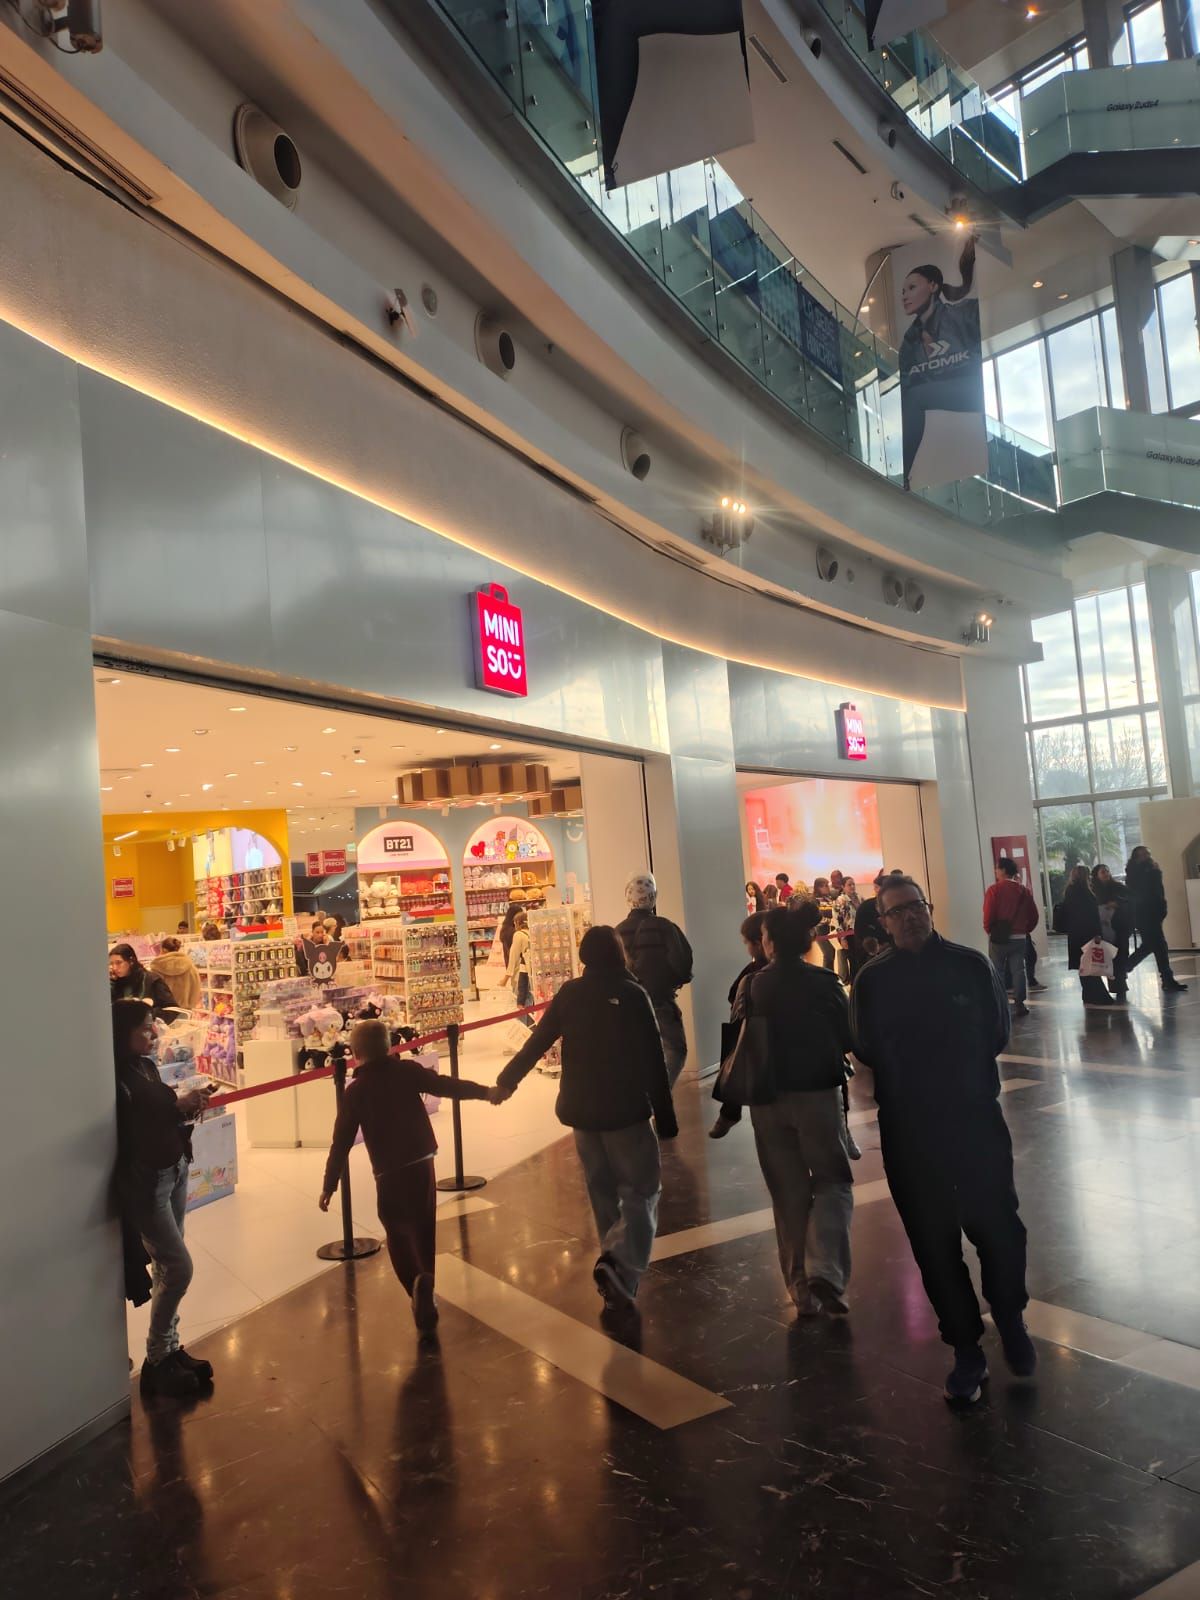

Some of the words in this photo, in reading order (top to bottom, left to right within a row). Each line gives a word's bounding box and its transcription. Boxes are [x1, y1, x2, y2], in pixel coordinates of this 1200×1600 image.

[909, 350, 970, 376] ATOMIK
[1146, 451, 1174, 464] Galaxy
[483, 609, 520, 646] MINI
[846, 718, 863, 734] MINI
[386, 838, 412, 850] BT21
